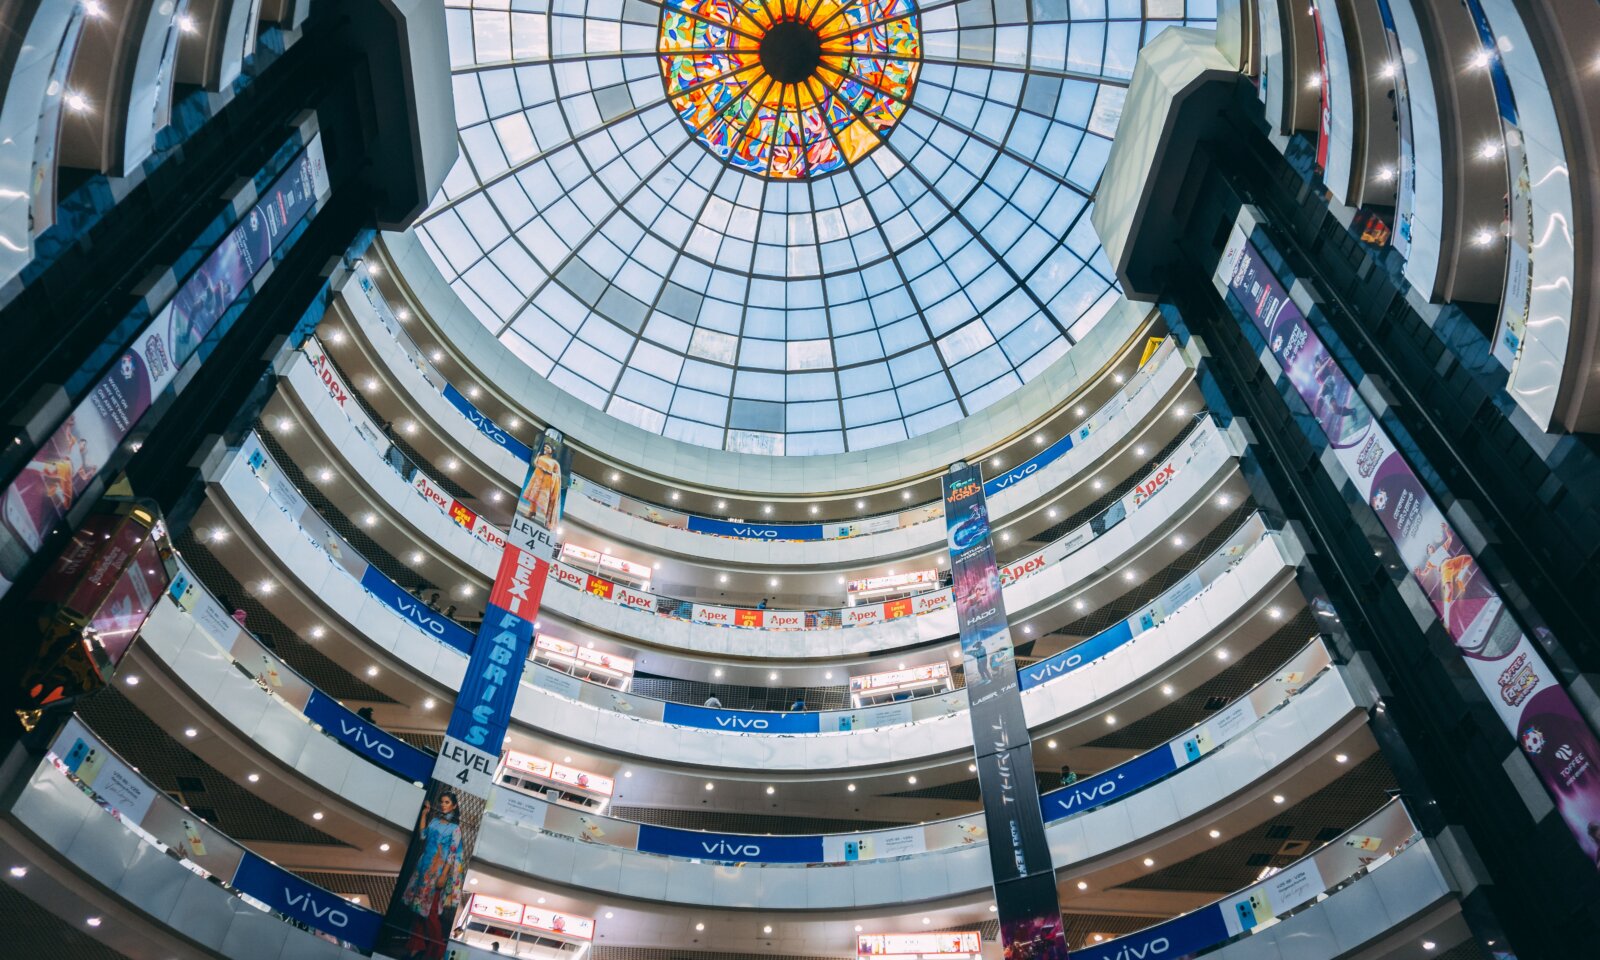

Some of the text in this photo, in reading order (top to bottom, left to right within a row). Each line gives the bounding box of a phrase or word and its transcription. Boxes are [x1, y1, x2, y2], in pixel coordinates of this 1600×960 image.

[313, 354, 347, 408] Apex
[469, 410, 506, 444] vivo
[997, 463, 1038, 489] vivo
[1132, 462, 1175, 505] Apex
[416, 478, 447, 509] Apex
[947, 486, 981, 503] WORLD
[513, 517, 554, 548] LEVEL
[733, 526, 778, 538] vivo
[525, 540, 536, 550] 4
[550, 563, 582, 586] Apex
[999, 553, 1046, 584] Apex
[506, 551, 541, 615] BEXI
[591, 581, 608, 592] Level
[616, 590, 651, 608] Apex
[919, 595, 947, 608] Apex
[397, 595, 444, 635] vivo
[699, 608, 727, 620] Apex
[770, 615, 798, 625] Apex
[848, 610, 877, 621] Apex
[967, 607, 996, 626] HADO
[1030, 653, 1083, 681] vivo
[464, 614, 521, 746] FABRICS
[1001, 682, 1017, 694] TAG
[715, 714, 769, 730] vivo
[341, 718, 394, 760] vivo
[441, 741, 493, 776] LEVEL
[1559, 752, 1585, 777] TOFFEE
[455, 768, 470, 785] 4
[1058, 779, 1116, 811] vivo
[702, 838, 760, 857] vivo
[284, 886, 349, 928] vivo
